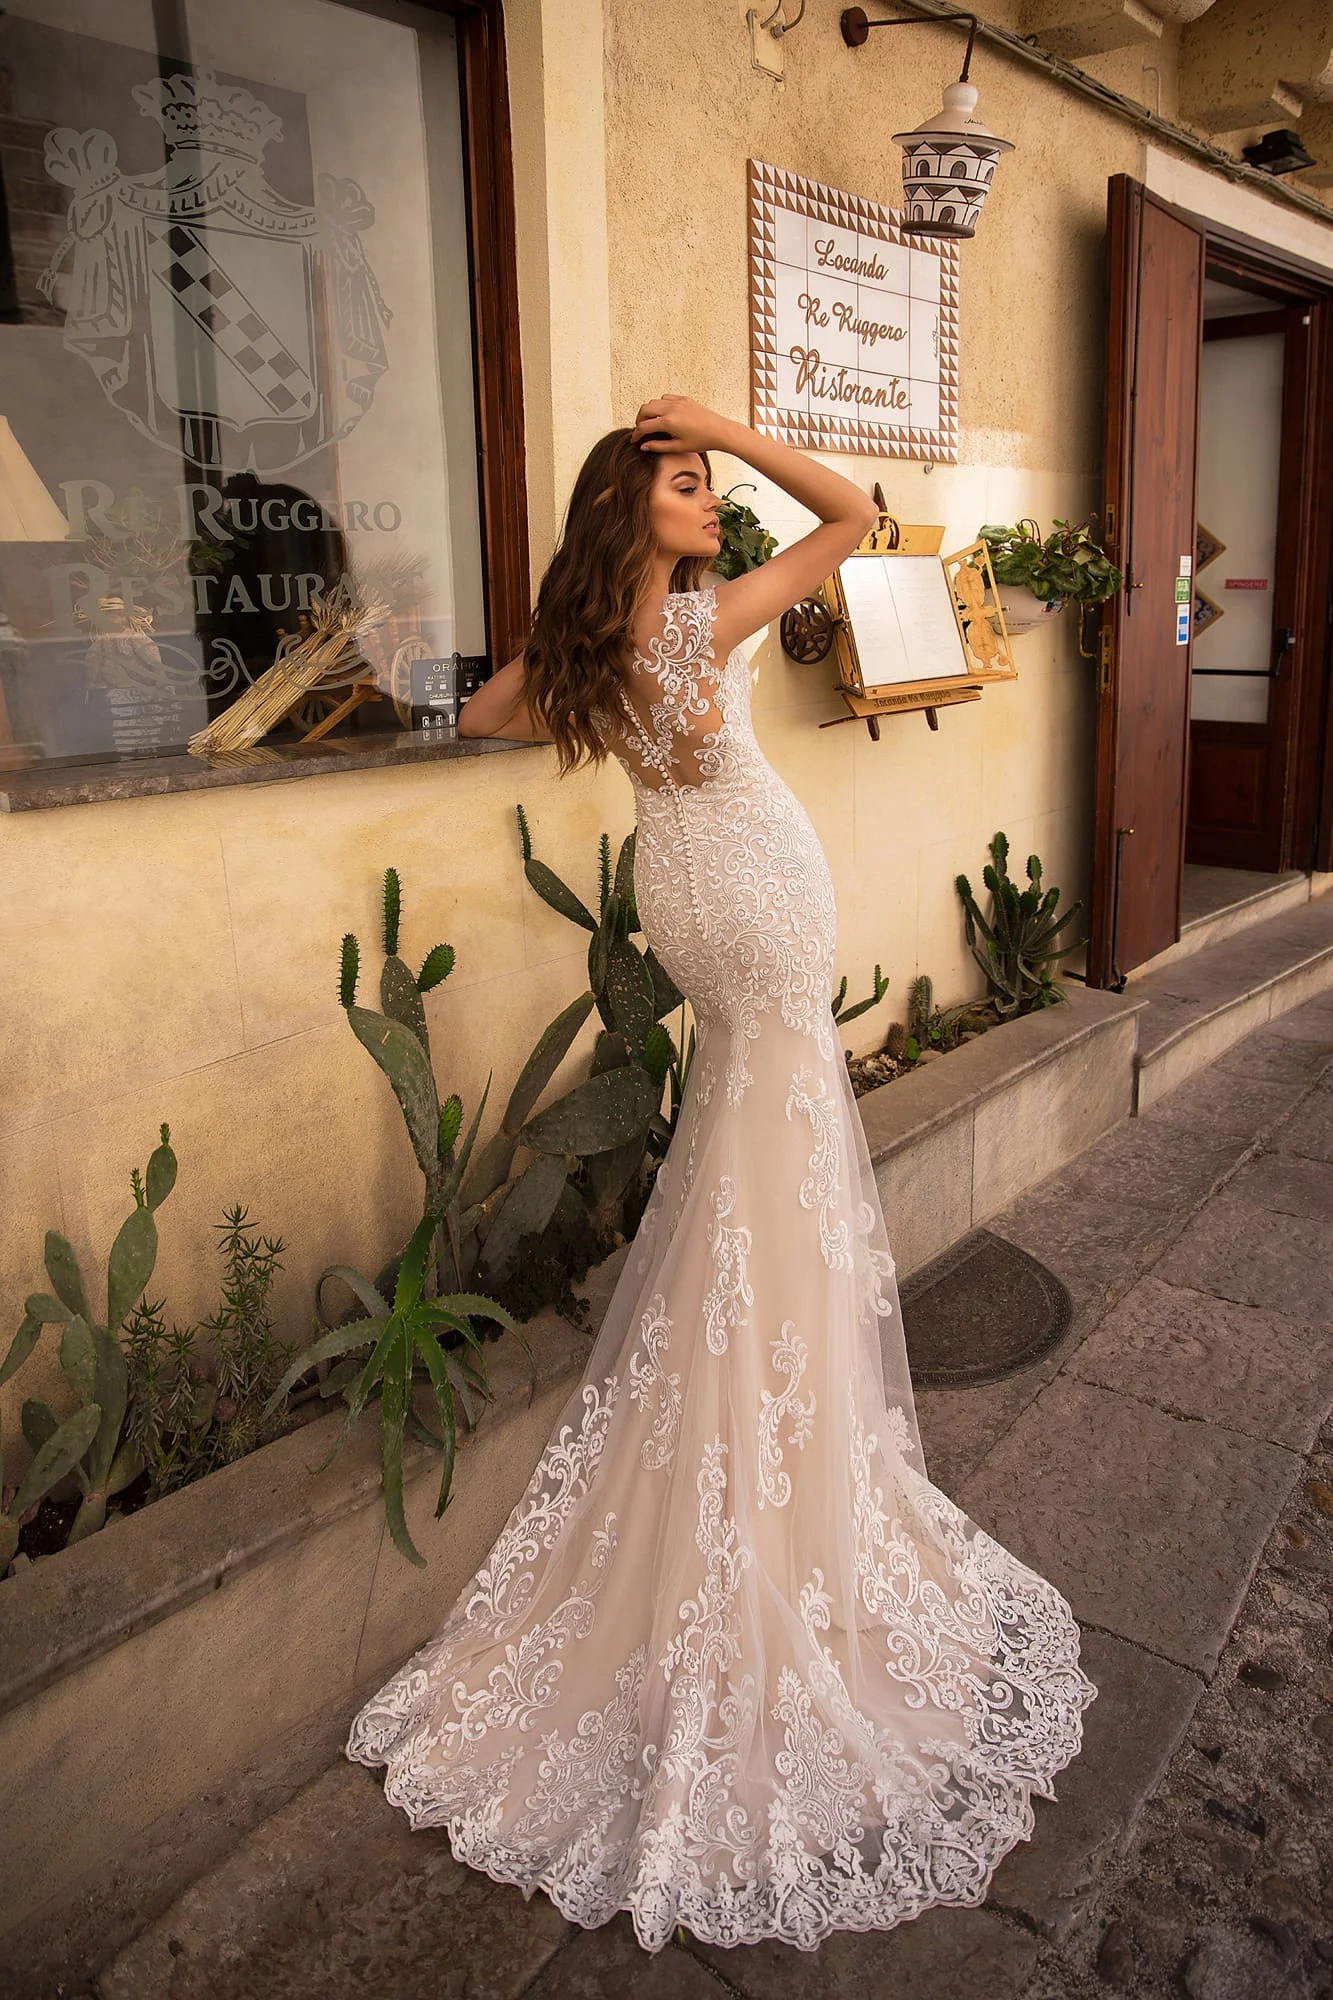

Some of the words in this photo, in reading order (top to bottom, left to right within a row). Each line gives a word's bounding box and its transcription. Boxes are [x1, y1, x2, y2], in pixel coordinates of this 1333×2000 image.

[814, 240, 889, 280] Locanda
[798, 293, 830, 328] Re
[832, 302, 908, 346] Ruggero
[790, 345, 912, 410] Ristorante
[174, 483, 402, 541] RUGGERO
